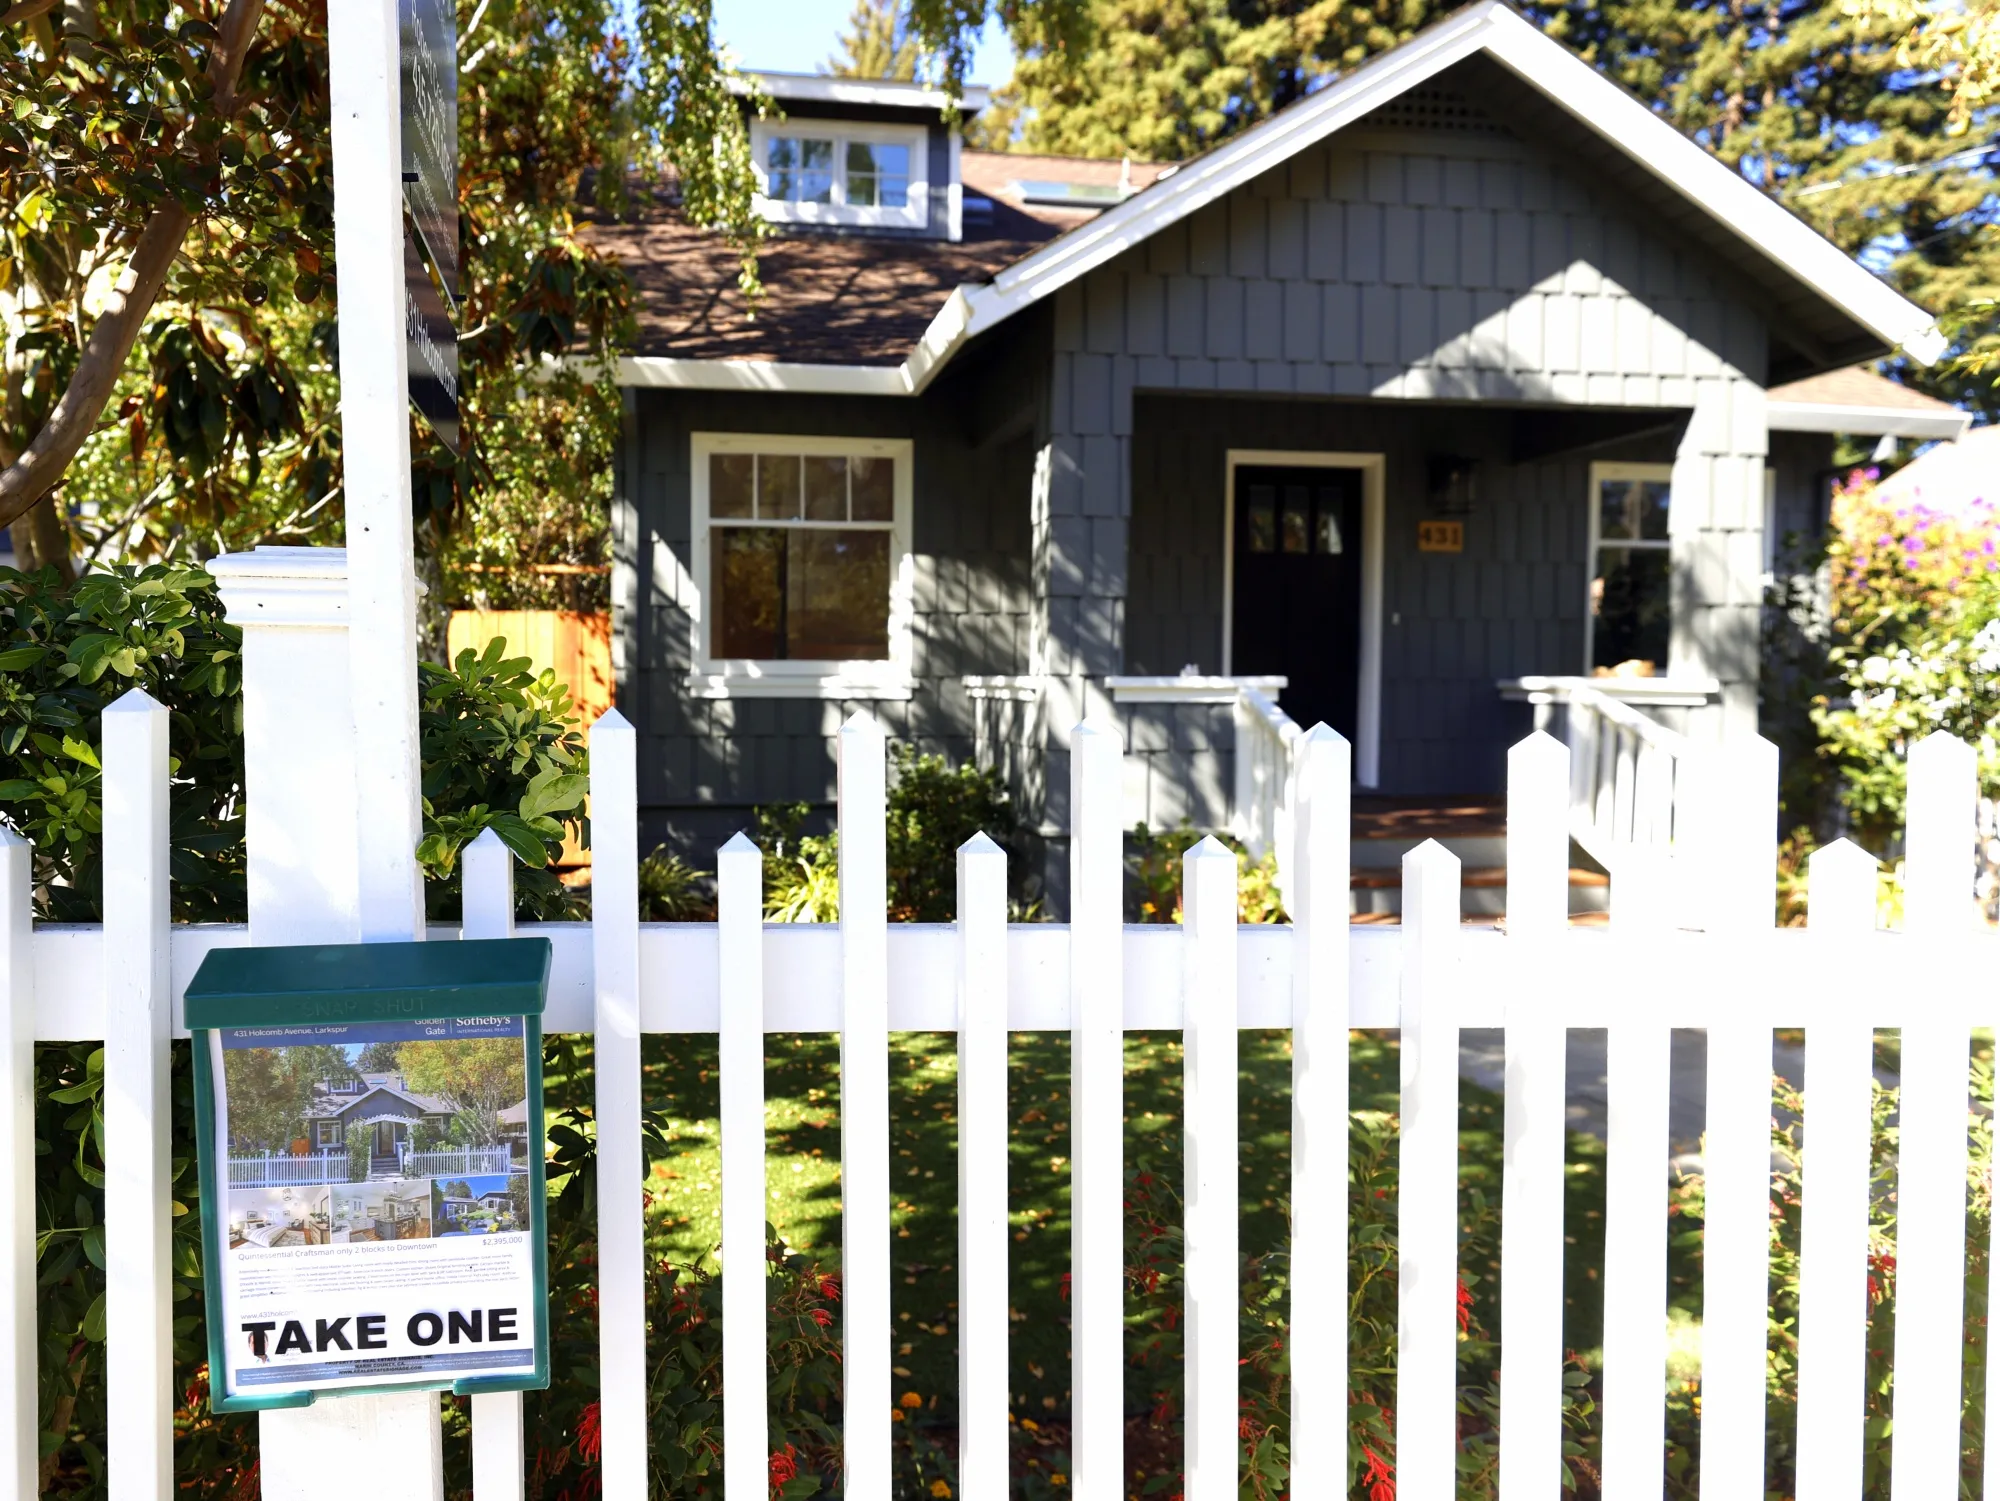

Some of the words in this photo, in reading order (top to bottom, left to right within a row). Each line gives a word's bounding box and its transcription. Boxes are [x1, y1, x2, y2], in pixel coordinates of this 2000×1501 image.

[1421, 527, 1460, 545] 431
[304, 1000, 356, 1017] SNAP
[374, 997, 427, 1014] SHUT
[456, 1016, 511, 1027] Sotheby's
[234, 1030, 247, 1038] 431
[249, 1028, 283, 1037] Holcomb
[284, 1027, 313, 1036] Avenue,
[315, 1026, 348, 1035] Larkspur
[425, 1027, 446, 1035] Gate
[482, 1236, 523, 1246] $2,395,000
[238, 1250, 294, 1261] Quintessential
[295, 1247, 335, 1258] Craftsman
[337, 1247, 352, 1256] only
[355, 1246, 360, 1254] 2
[361, 1245, 385, 1254] blocks
[387, 1244, 395, 1252] to
[397, 1242, 438, 1251] Downtown
[242, 1315, 388, 1357] TAKE
[407, 1307, 519, 1347] ONE
